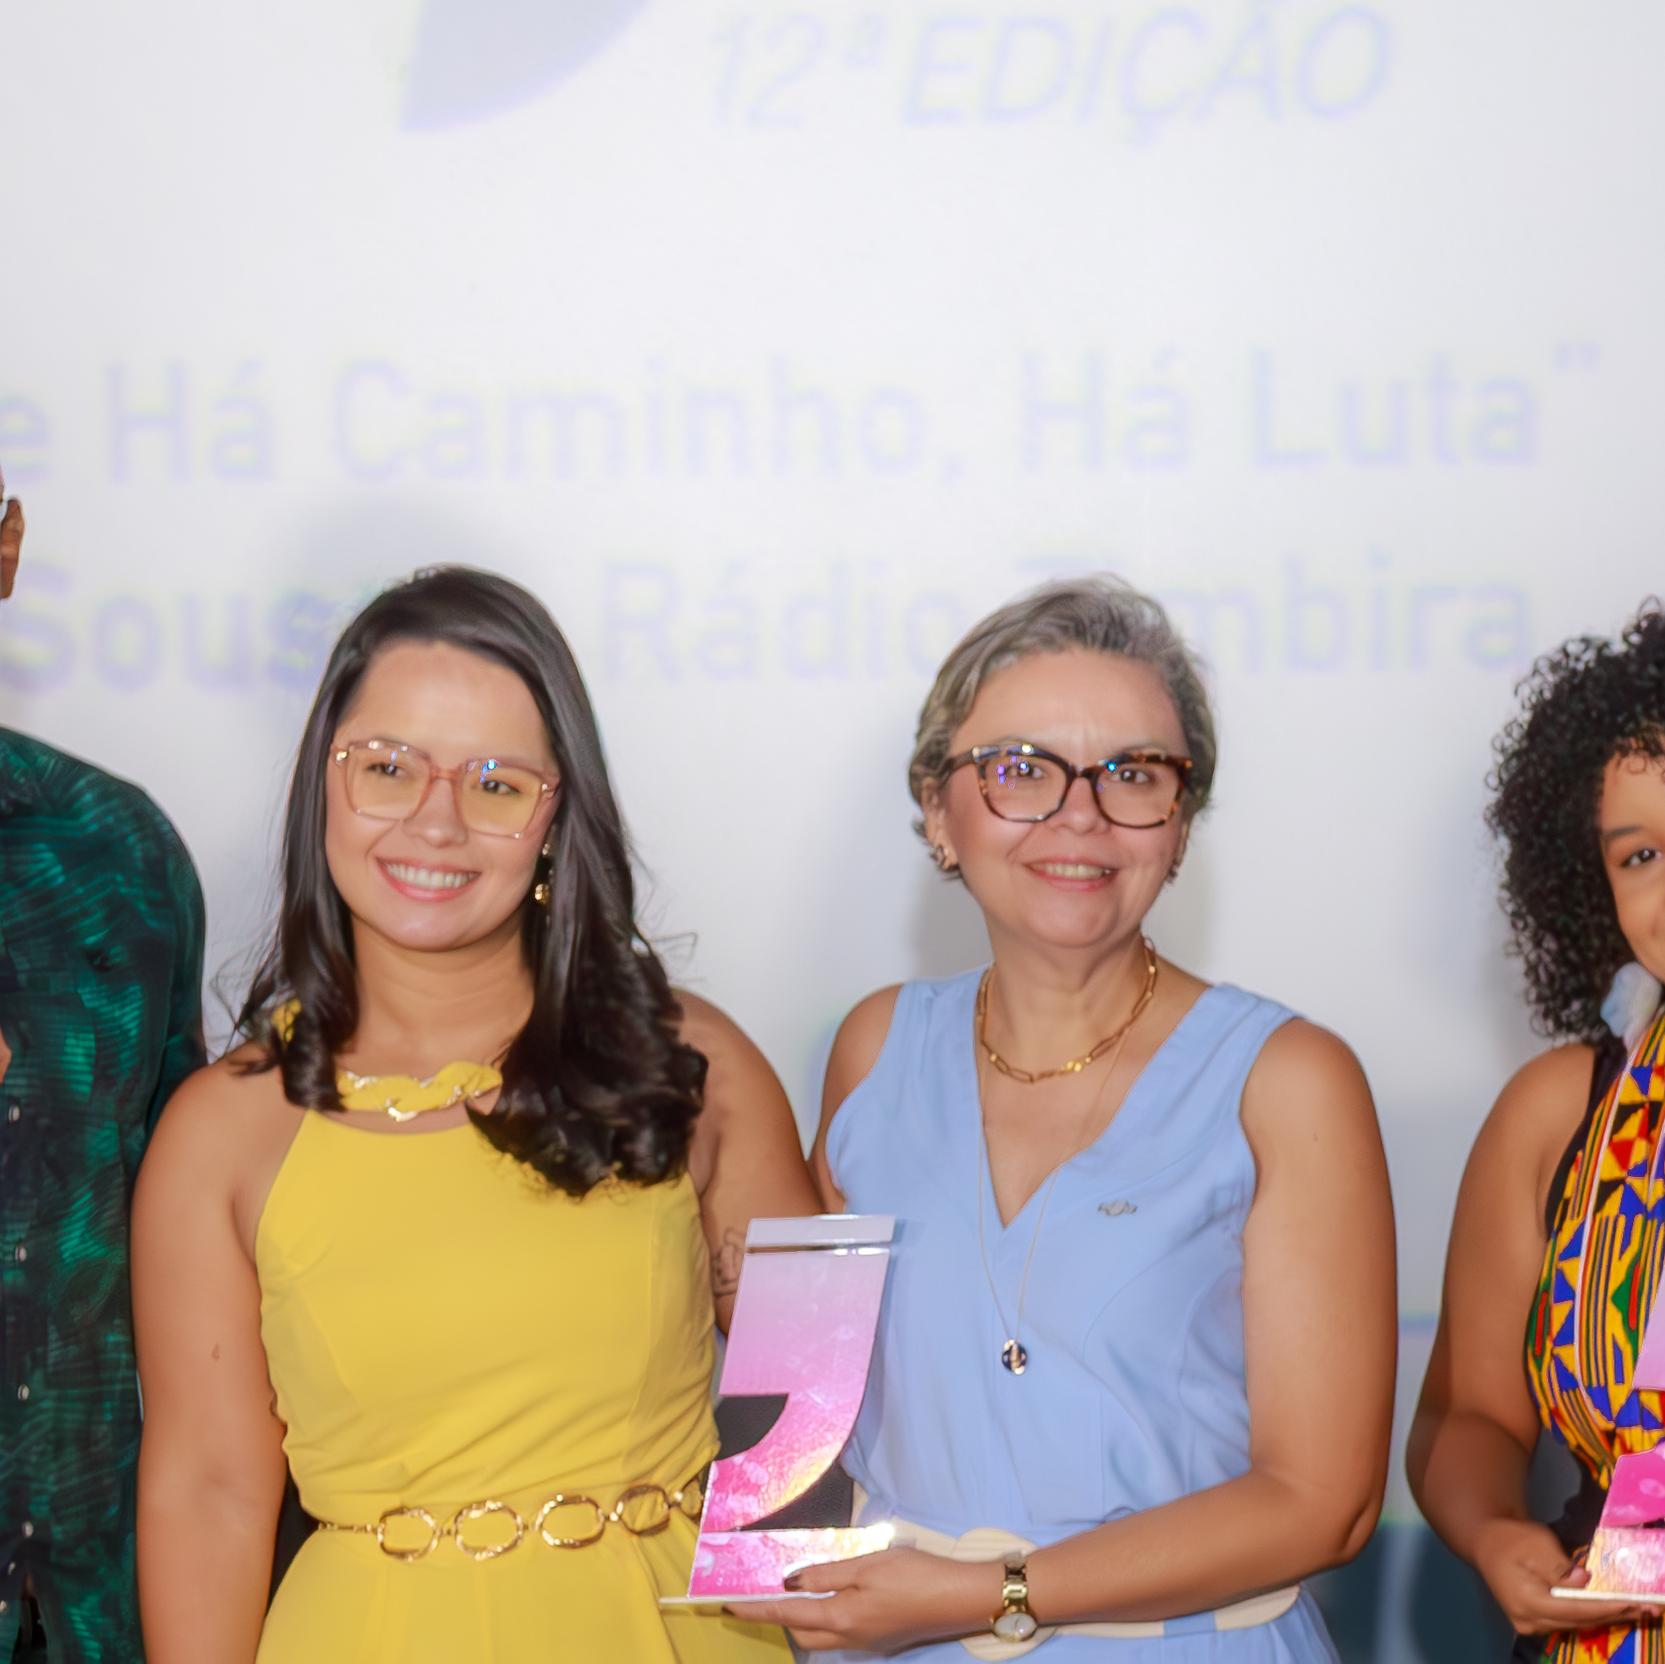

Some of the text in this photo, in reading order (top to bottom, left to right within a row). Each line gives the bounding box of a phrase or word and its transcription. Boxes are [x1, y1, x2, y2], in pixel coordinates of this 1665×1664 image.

[104, 358, 277, 485] Há
[330, 352, 964, 486] Caminho,
[1016, 344, 1193, 475] Há
[594, 550, 970, 684] Rádio
